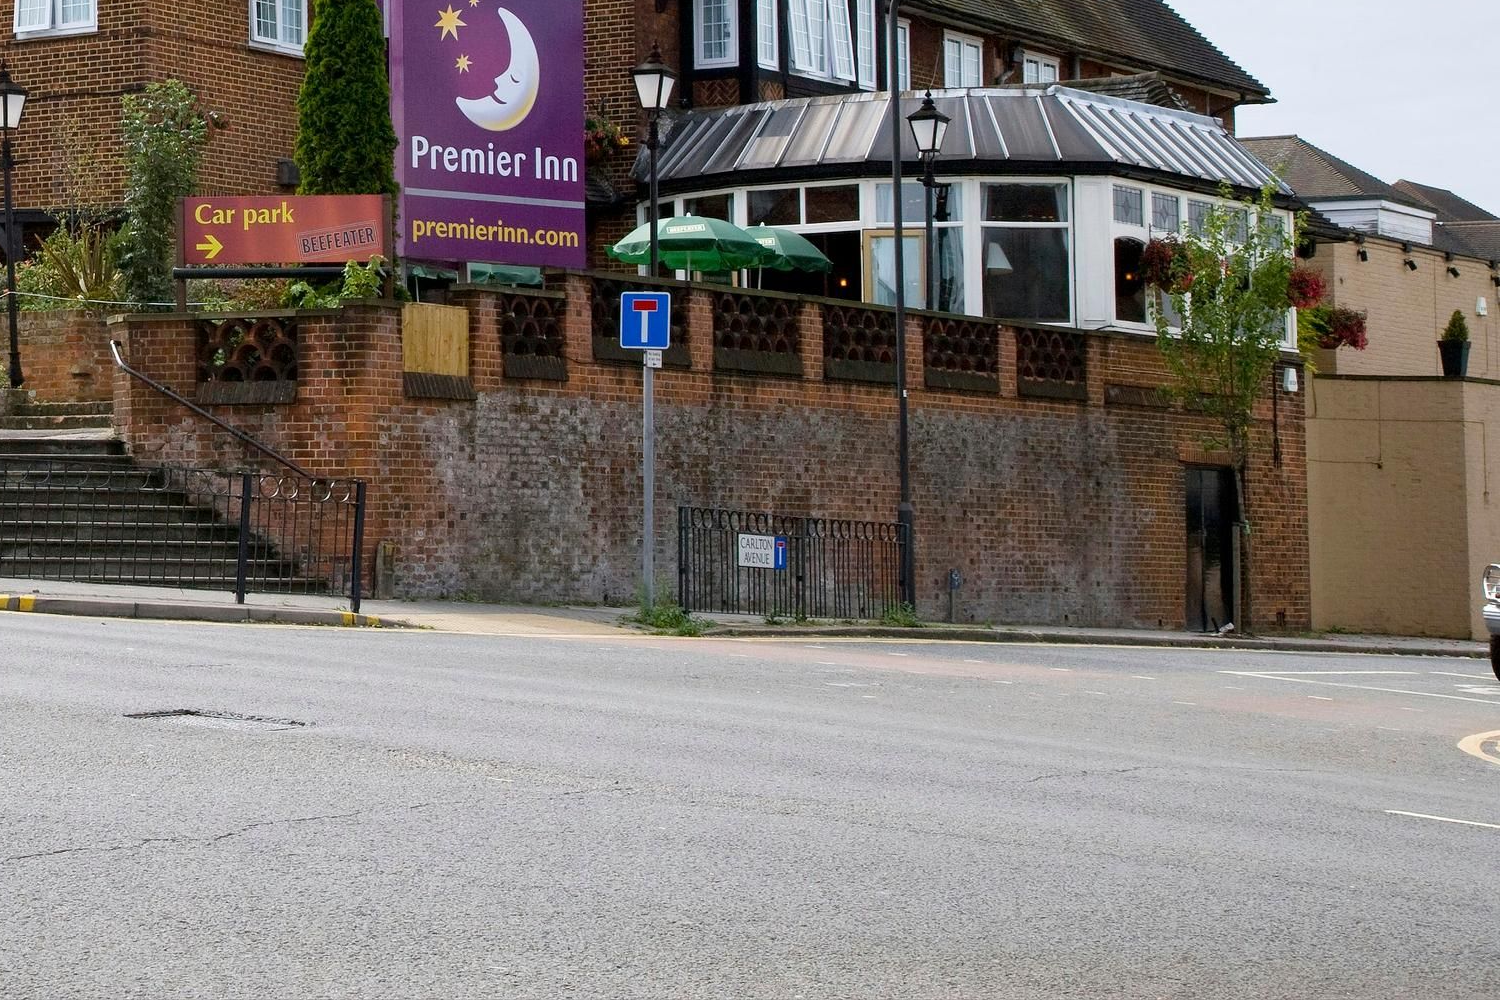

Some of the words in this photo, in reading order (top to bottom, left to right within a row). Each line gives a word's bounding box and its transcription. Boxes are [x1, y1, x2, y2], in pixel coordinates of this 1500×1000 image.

[411, 135, 526, 177] Premier
[535, 147, 578, 182] Inn
[195, 203, 235, 226] Car
[243, 201, 295, 231] park
[302, 227, 375, 254] BEEFEATER
[412, 217, 579, 248] premierinn.com
[740, 537, 773, 550] CARLTON
[744, 551, 770, 565] AVENUE
